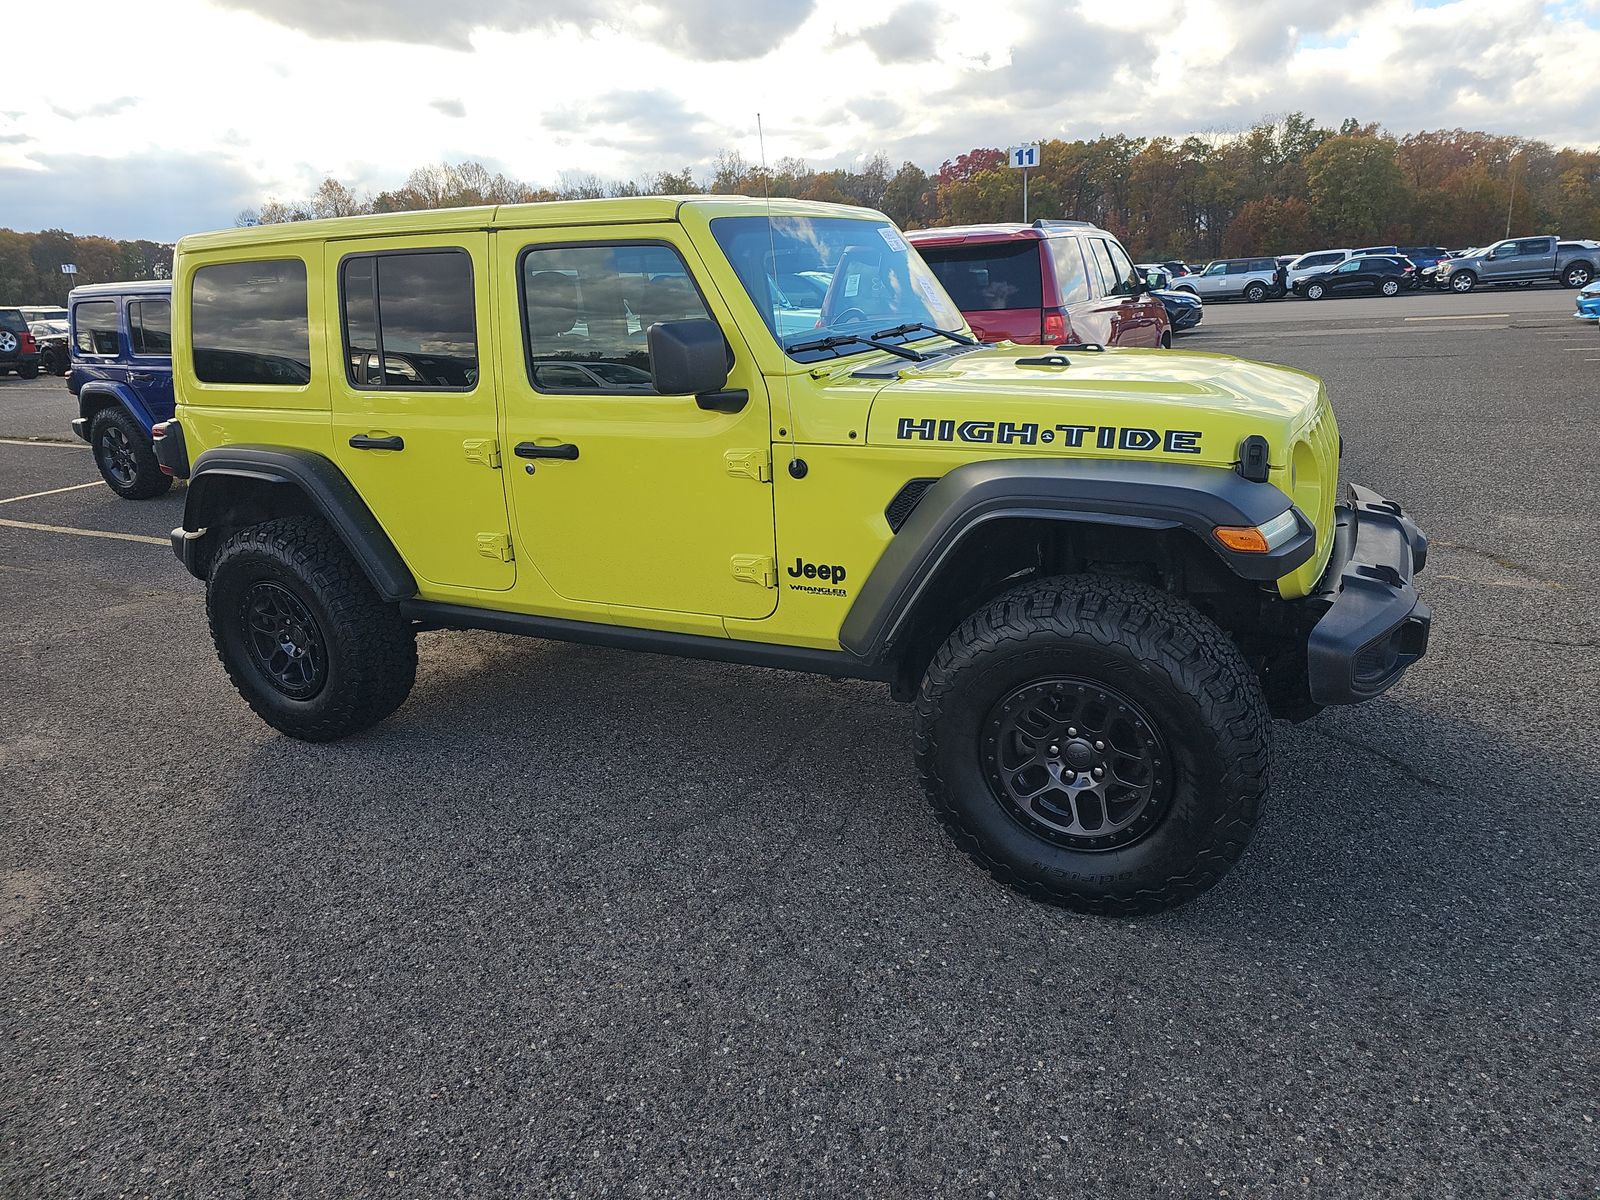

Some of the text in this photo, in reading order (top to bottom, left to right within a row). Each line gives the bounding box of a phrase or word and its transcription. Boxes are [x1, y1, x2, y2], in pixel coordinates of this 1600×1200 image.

[1015, 148, 1034, 166] 11
[896, 417, 1203, 454] HIGH TIDE
[787, 557, 846, 584] Jeep
[789, 584, 847, 595] WRANGLER
